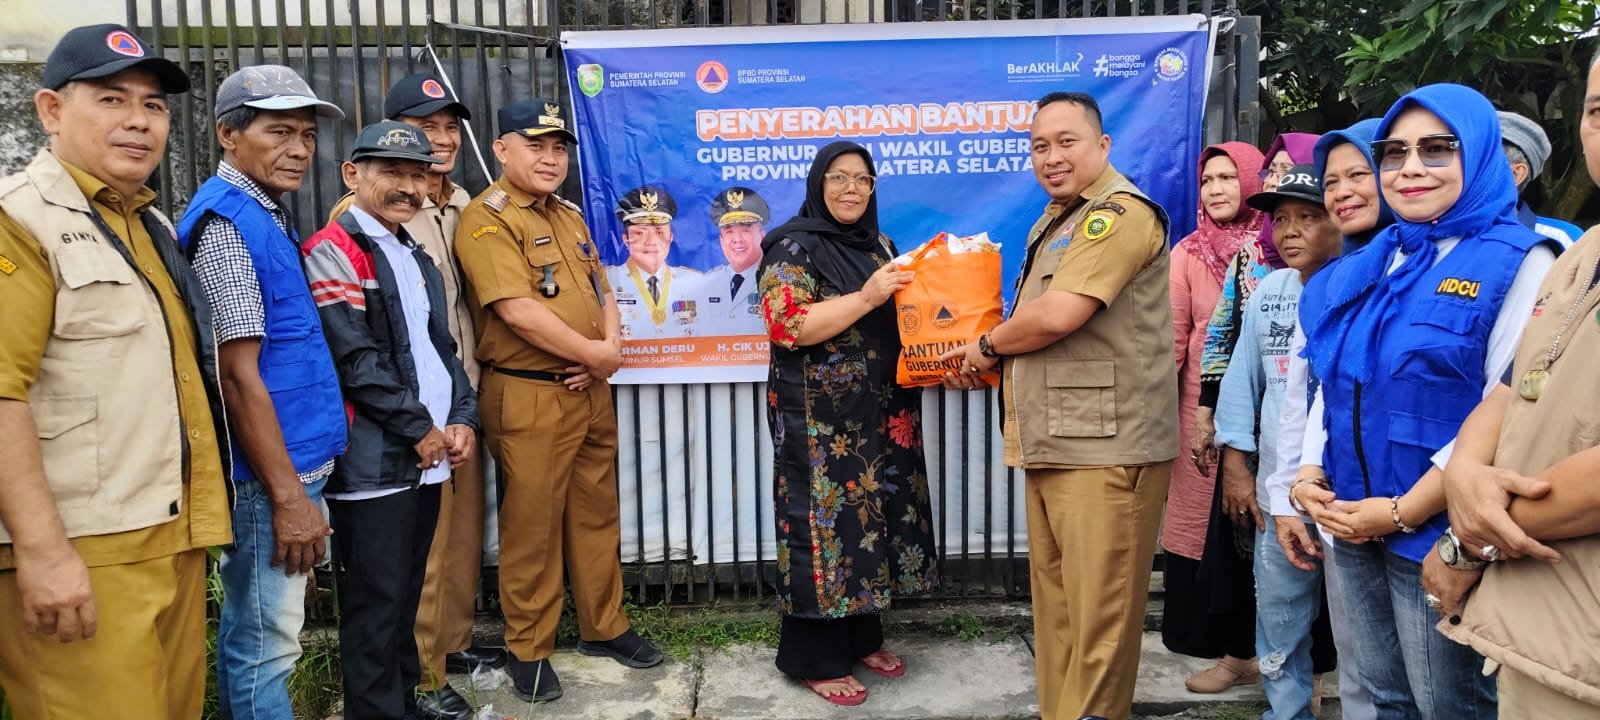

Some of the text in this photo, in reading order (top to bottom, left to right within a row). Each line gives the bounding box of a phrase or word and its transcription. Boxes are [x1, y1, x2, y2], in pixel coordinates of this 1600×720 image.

[1109, 54, 1141, 63] bangga
[1007, 61, 1081, 74] BerAKHLAK
[1109, 61, 1146, 70] melayani
[609, 71, 686, 80] PEMERINTAH PROVINSI
[737, 68, 790, 77] BPBD PROVINSI
[1109, 70, 1138, 78] bangsa
[610, 79, 679, 88] SUMATERA SELATAN
[737, 75, 806, 84] SUMATERA SELATAN
[697, 102, 1039, 138] PENYERAHAN BANTUA
[697, 145, 817, 164] GUBERNUR
[879, 141, 952, 157] WAKIL
[958, 139, 1031, 156] GUBER
[722, 156, 1034, 181] PROVIN ATERA SELATA
[1437, 278, 1480, 298] HDCU
[622, 344, 695, 355] RMAN DERU
[717, 343, 730, 352] H.
[732, 342, 752, 352] CIK
[651, 355, 683, 364] SUMSEL
[701, 353, 770, 362] WAKIL GUBERNU
